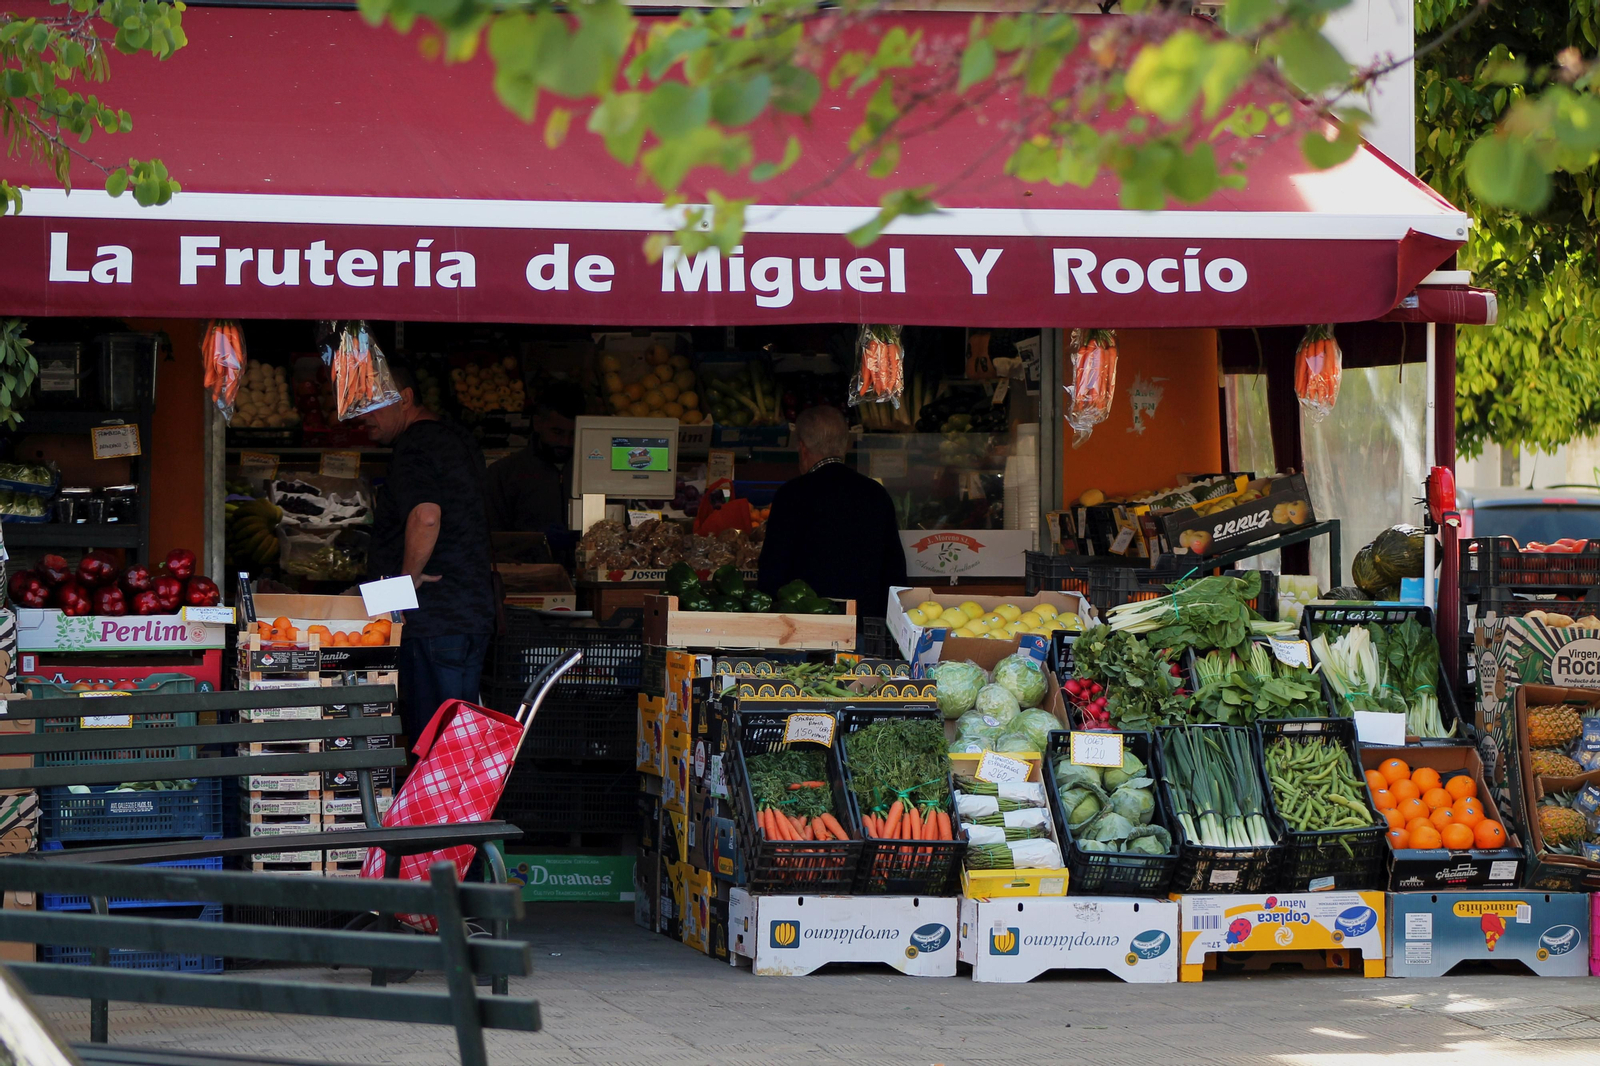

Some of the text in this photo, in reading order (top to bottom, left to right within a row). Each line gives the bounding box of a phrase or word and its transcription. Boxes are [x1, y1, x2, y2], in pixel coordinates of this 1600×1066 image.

[49, 232, 1248, 308] La Frutería de Miguel Y Rocío
[1212, 509, 1271, 539] ERRUZ
[100, 620, 188, 643] Perlim
[1568, 649, 1598, 661] Virgen
[1435, 870, 1478, 880] Gracianito
[1279, 900, 1306, 908] Natur
[1458, 903, 1517, 915] uanchita
[1257, 911, 1311, 925] Coplaca
[804, 924, 900, 944] europlátano
[1023, 931, 1120, 951] europlátano
